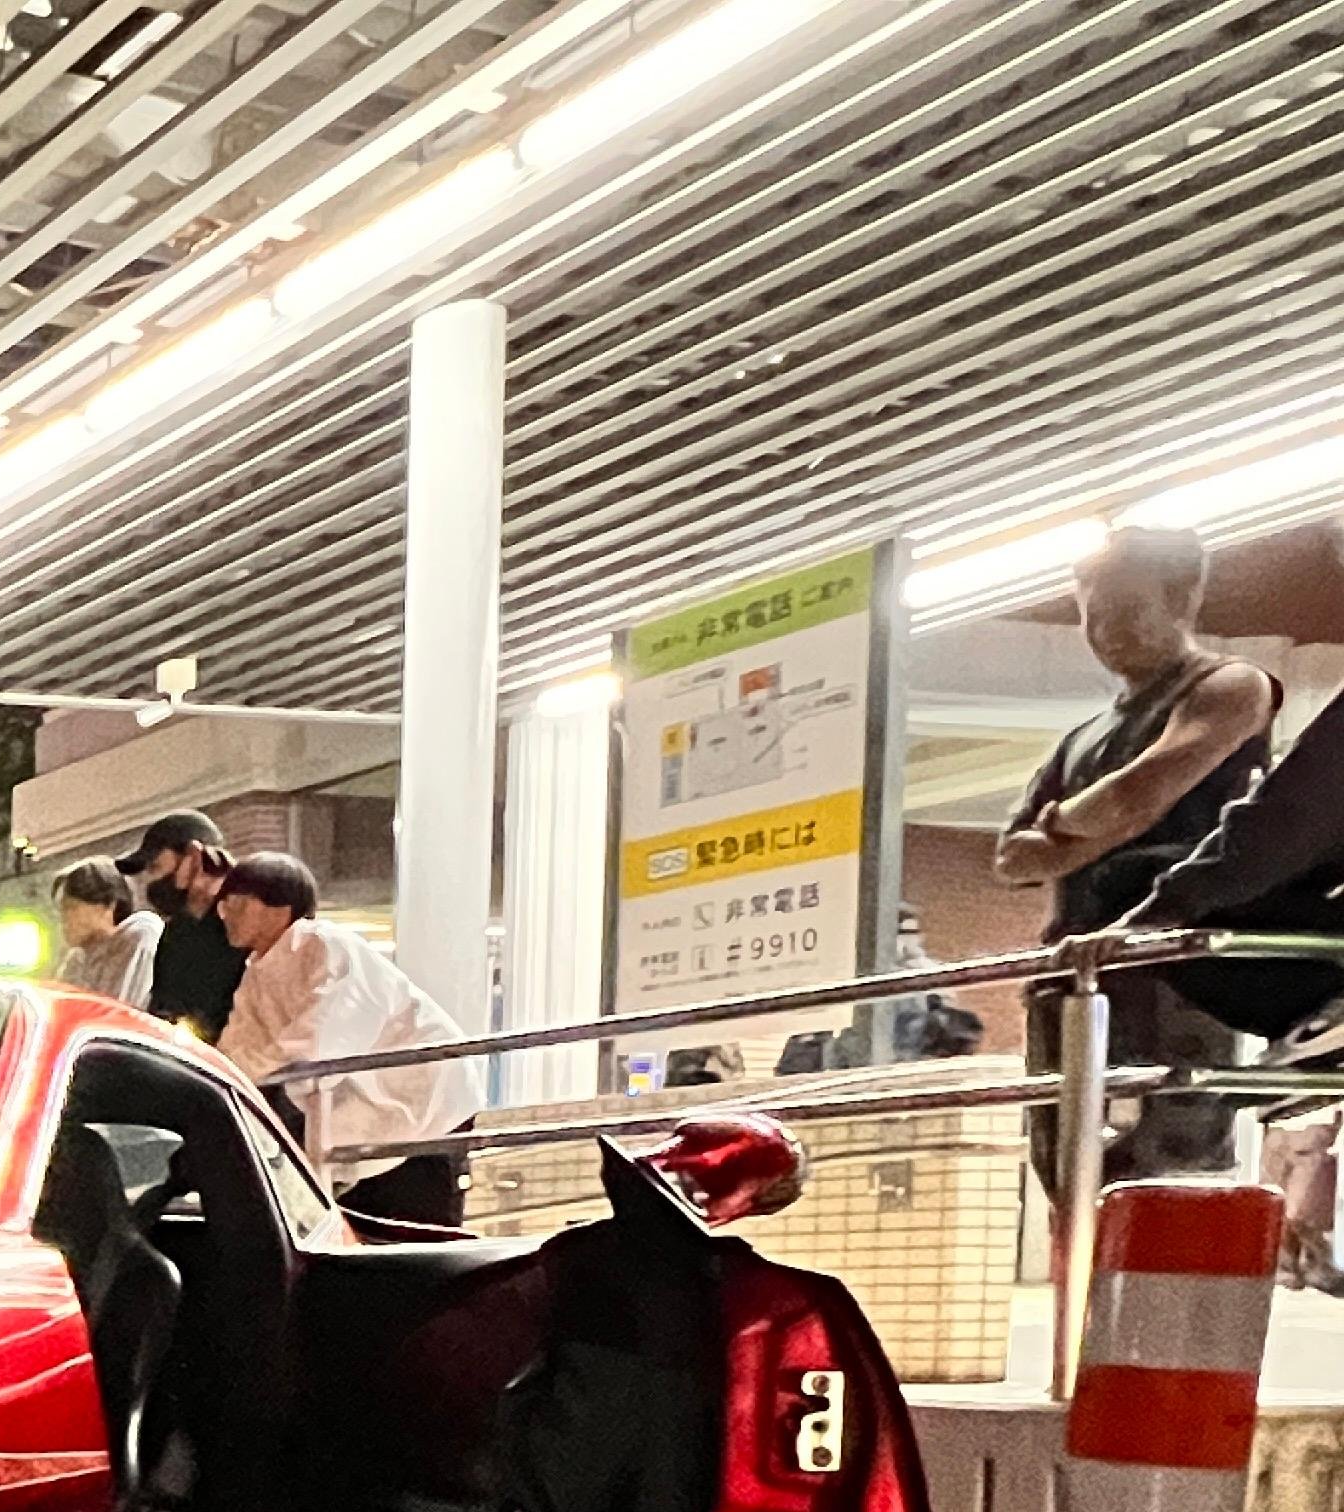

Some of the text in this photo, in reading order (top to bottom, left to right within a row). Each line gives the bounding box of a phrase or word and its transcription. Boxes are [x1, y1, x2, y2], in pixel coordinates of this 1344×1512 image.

[651, 820, 816, 874] SOS 緊急時には
[725, 881, 820, 923] 非常電話
